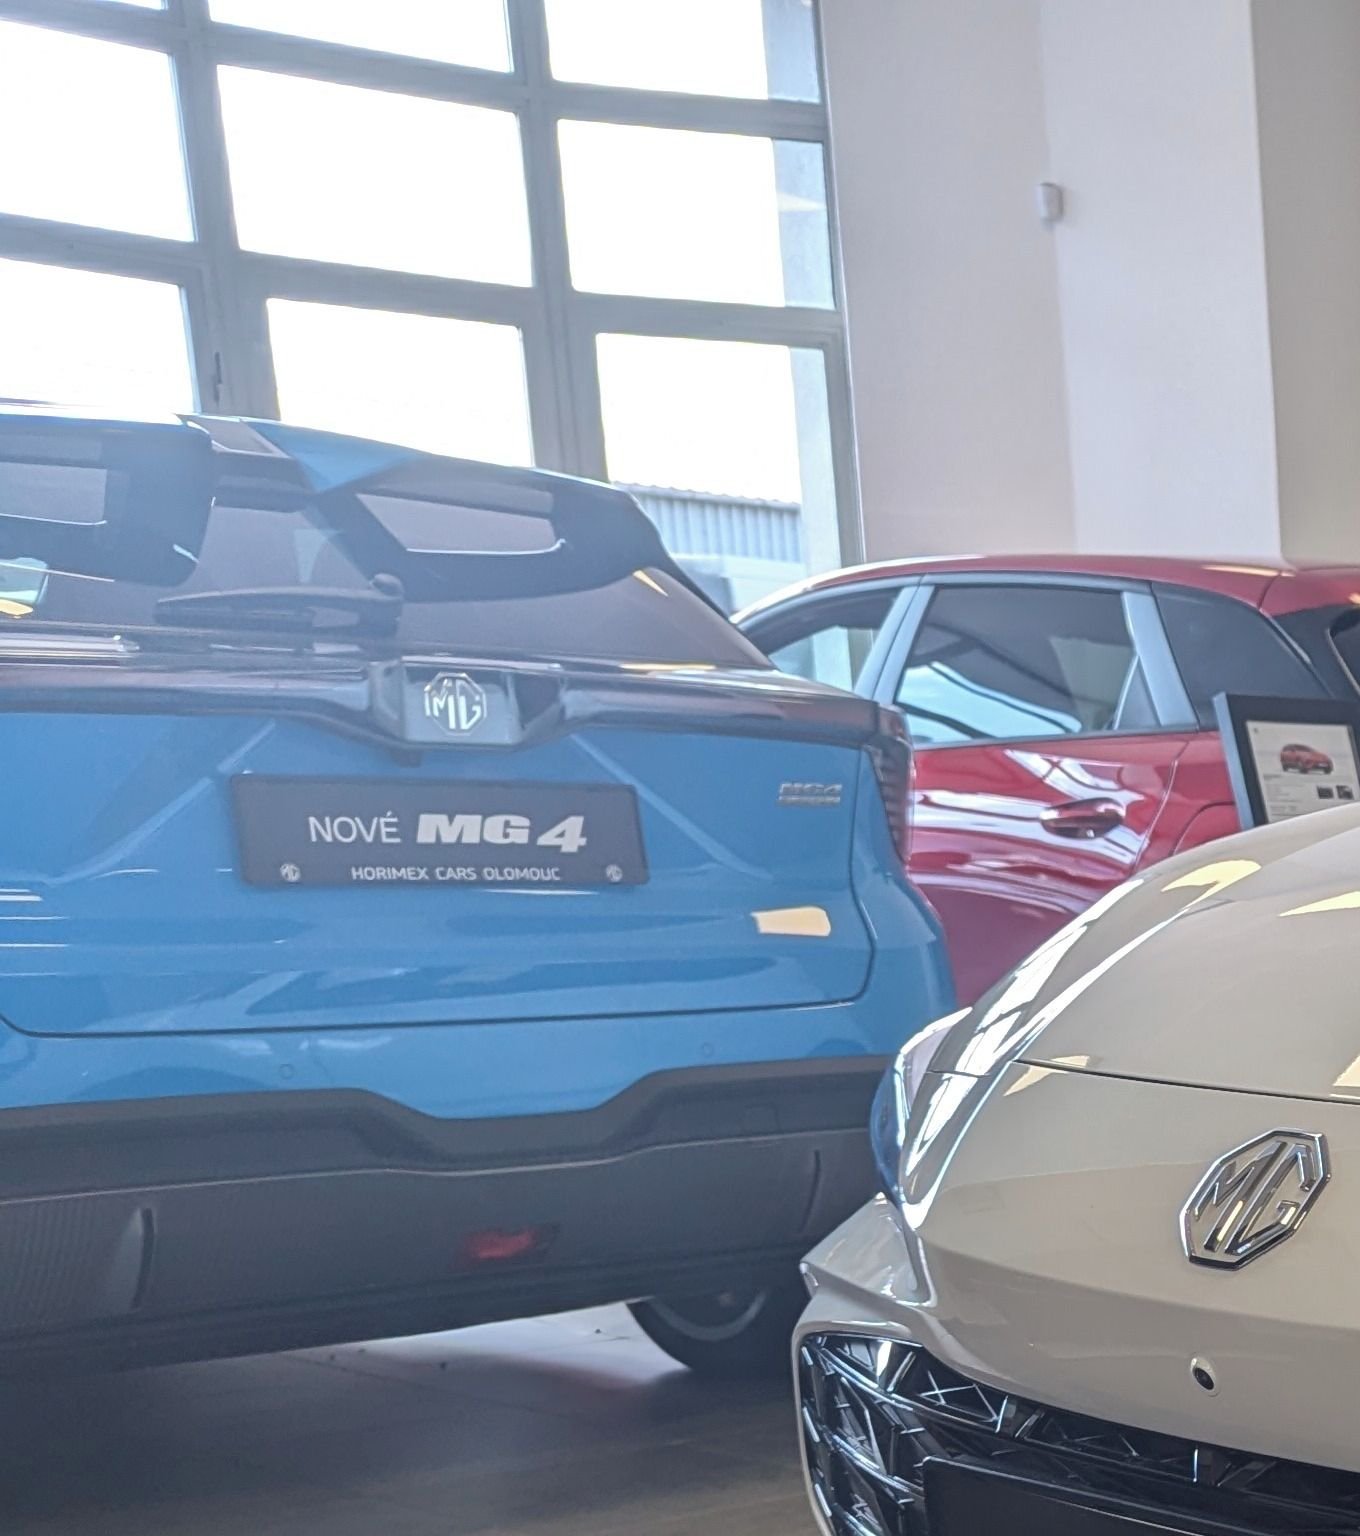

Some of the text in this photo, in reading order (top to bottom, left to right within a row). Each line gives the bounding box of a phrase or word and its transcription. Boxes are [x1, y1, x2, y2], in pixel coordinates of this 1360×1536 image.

[426, 674, 486, 733] MG
[308, 811, 400, 845] NOVÉ
[351, 866, 560, 881] HORIMEX CARS OLOMOUC
[1189, 1137, 1321, 1260] MG
